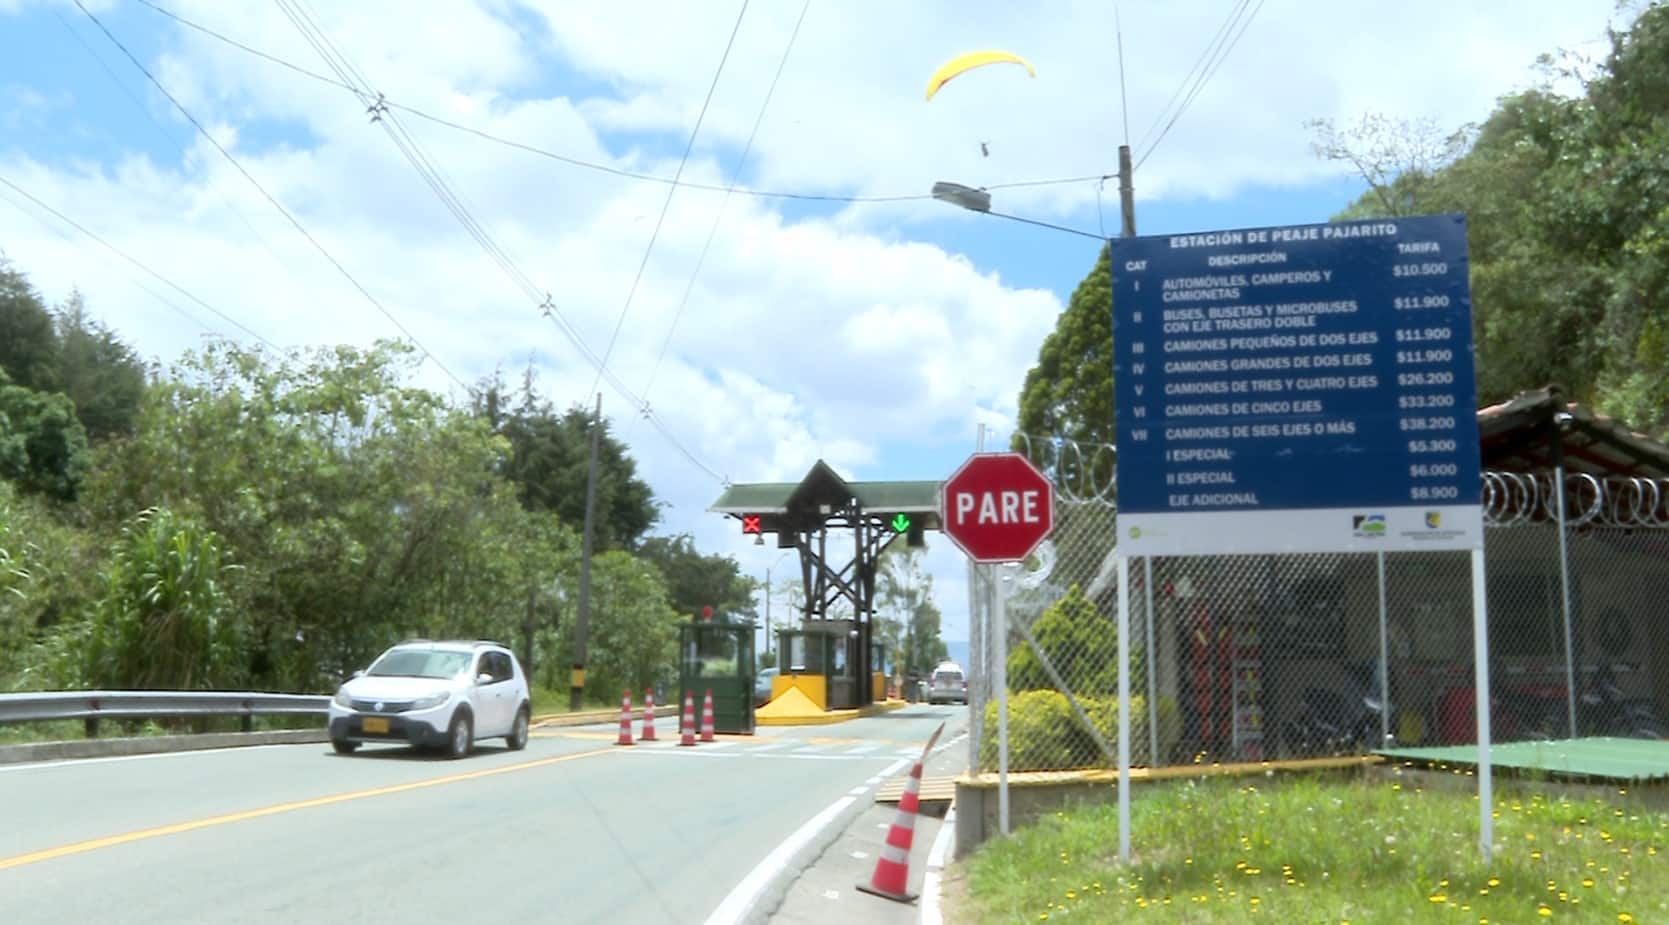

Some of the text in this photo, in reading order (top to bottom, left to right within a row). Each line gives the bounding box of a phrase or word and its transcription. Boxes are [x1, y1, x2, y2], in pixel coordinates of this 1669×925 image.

[1170, 223, 1397, 248] ESTACIÓN DE PEAJE PAJARITO
[1397, 242, 1440, 254] TARIFA
[1125, 260, 1147, 272] CAT
[1208, 252, 1287, 267] DESCRIPCIÓN
[1393, 263, 1448, 277] $10.500
[1251, 271, 1320, 285] CAMPEROS
[1324, 271, 1332, 281] Y
[1162, 288, 1240, 302] CAMIONETAS
[1208, 305, 1262, 319] BUSETAS
[1265, 305, 1273, 315] Y
[1276, 300, 1358, 315] MICROBUSES
[1394, 296, 1449, 309] $11.900
[1133, 311, 1142, 323] II
[1163, 315, 1316, 333] CON EJE TRASERO DOBLE
[1164, 331, 1378, 352] CAMIONES PEQUEÑOS DE DOS EJES
[1395, 328, 1451, 342] $11.900
[1132, 342, 1144, 354] III
[1164, 353, 1373, 373] CAMIONES GRANDES DE DOS EJES
[1397, 349, 1452, 363] $11.900
[1132, 363, 1145, 375] IV
[1134, 384, 1143, 396] V
[1165, 376, 1378, 395] CAMIONES DE TRES Y CUATRO EJES
[1165, 400, 1322, 416] CAMIONES DE CINCO EJES
[1399, 395, 1454, 408] $33.200
[1133, 406, 1146, 418] VI
[1132, 429, 1147, 441] VII
[1165, 419, 1356, 440] CAMIONES DE SEIS EJES O MÁS
[1173, 448, 1232, 461] ESPECIAL
[1166, 471, 1235, 484] II ESPECIAL
[1169, 492, 1258, 506] EJE ADICIONAL
[956, 490, 1040, 526] PARE
